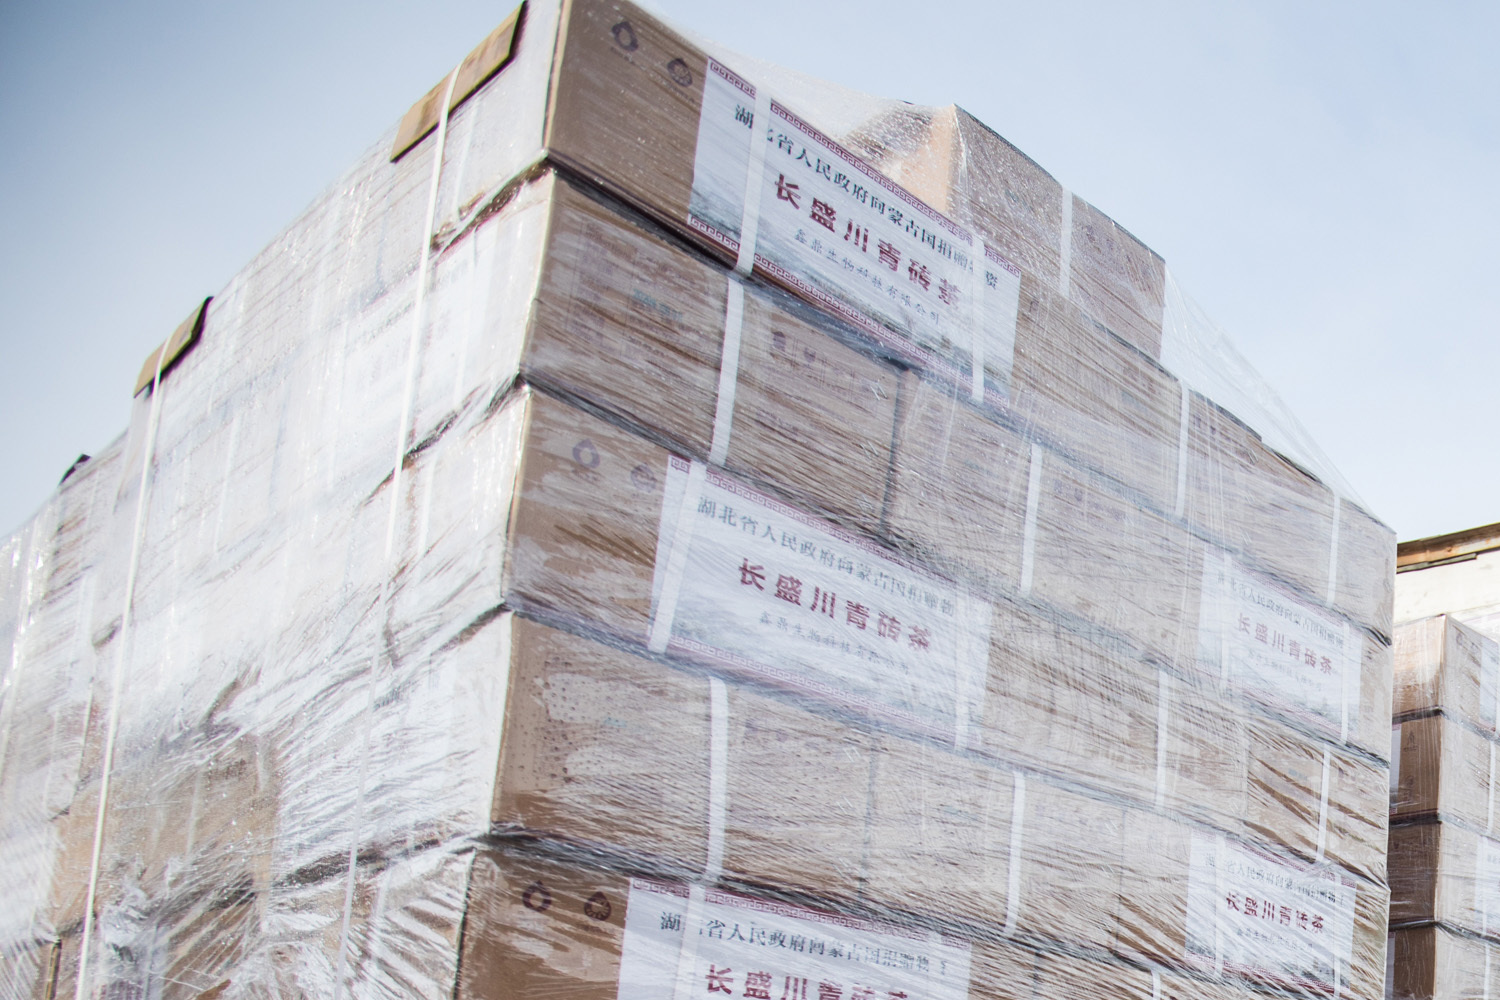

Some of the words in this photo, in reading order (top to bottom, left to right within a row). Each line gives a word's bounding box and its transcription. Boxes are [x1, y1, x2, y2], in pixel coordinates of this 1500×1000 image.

[775, 173, 961, 308] 长盛川青砖茶
[738, 557, 931, 653] 长盛川青砖茶
[1238, 612, 1333, 676] 长盛川青砖茶
